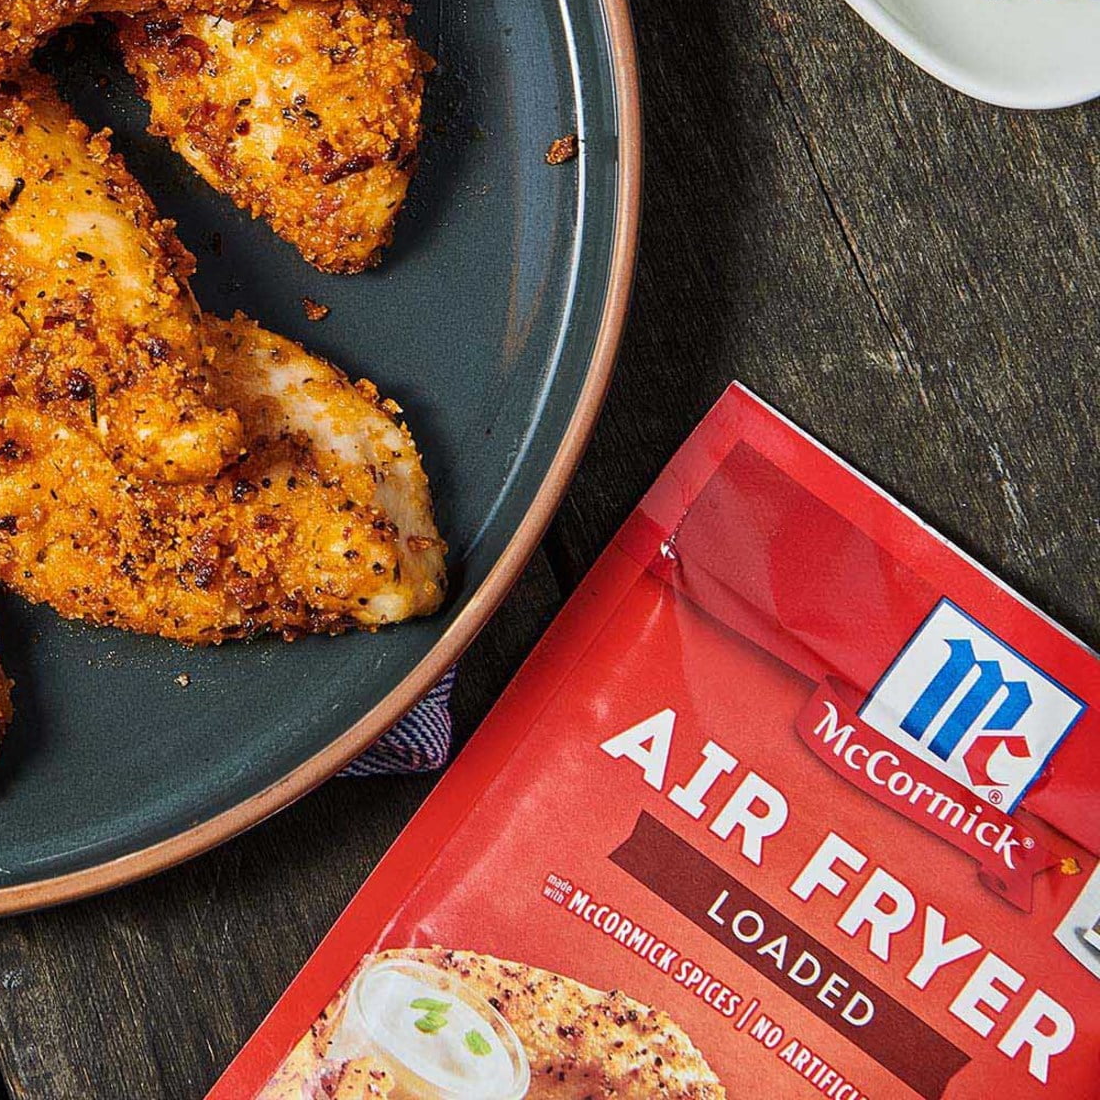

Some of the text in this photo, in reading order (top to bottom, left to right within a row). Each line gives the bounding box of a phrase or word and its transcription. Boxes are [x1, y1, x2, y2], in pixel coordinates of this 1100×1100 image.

[542, 885, 566, 905] with
[546, 873, 574, 895] made
[600, 707, 1076, 1084] AIR FRYER
[567, 889, 869, 1100] McCORMICK SPICES NO ARTIFIC
[707, 889, 876, 1027] LOADED
